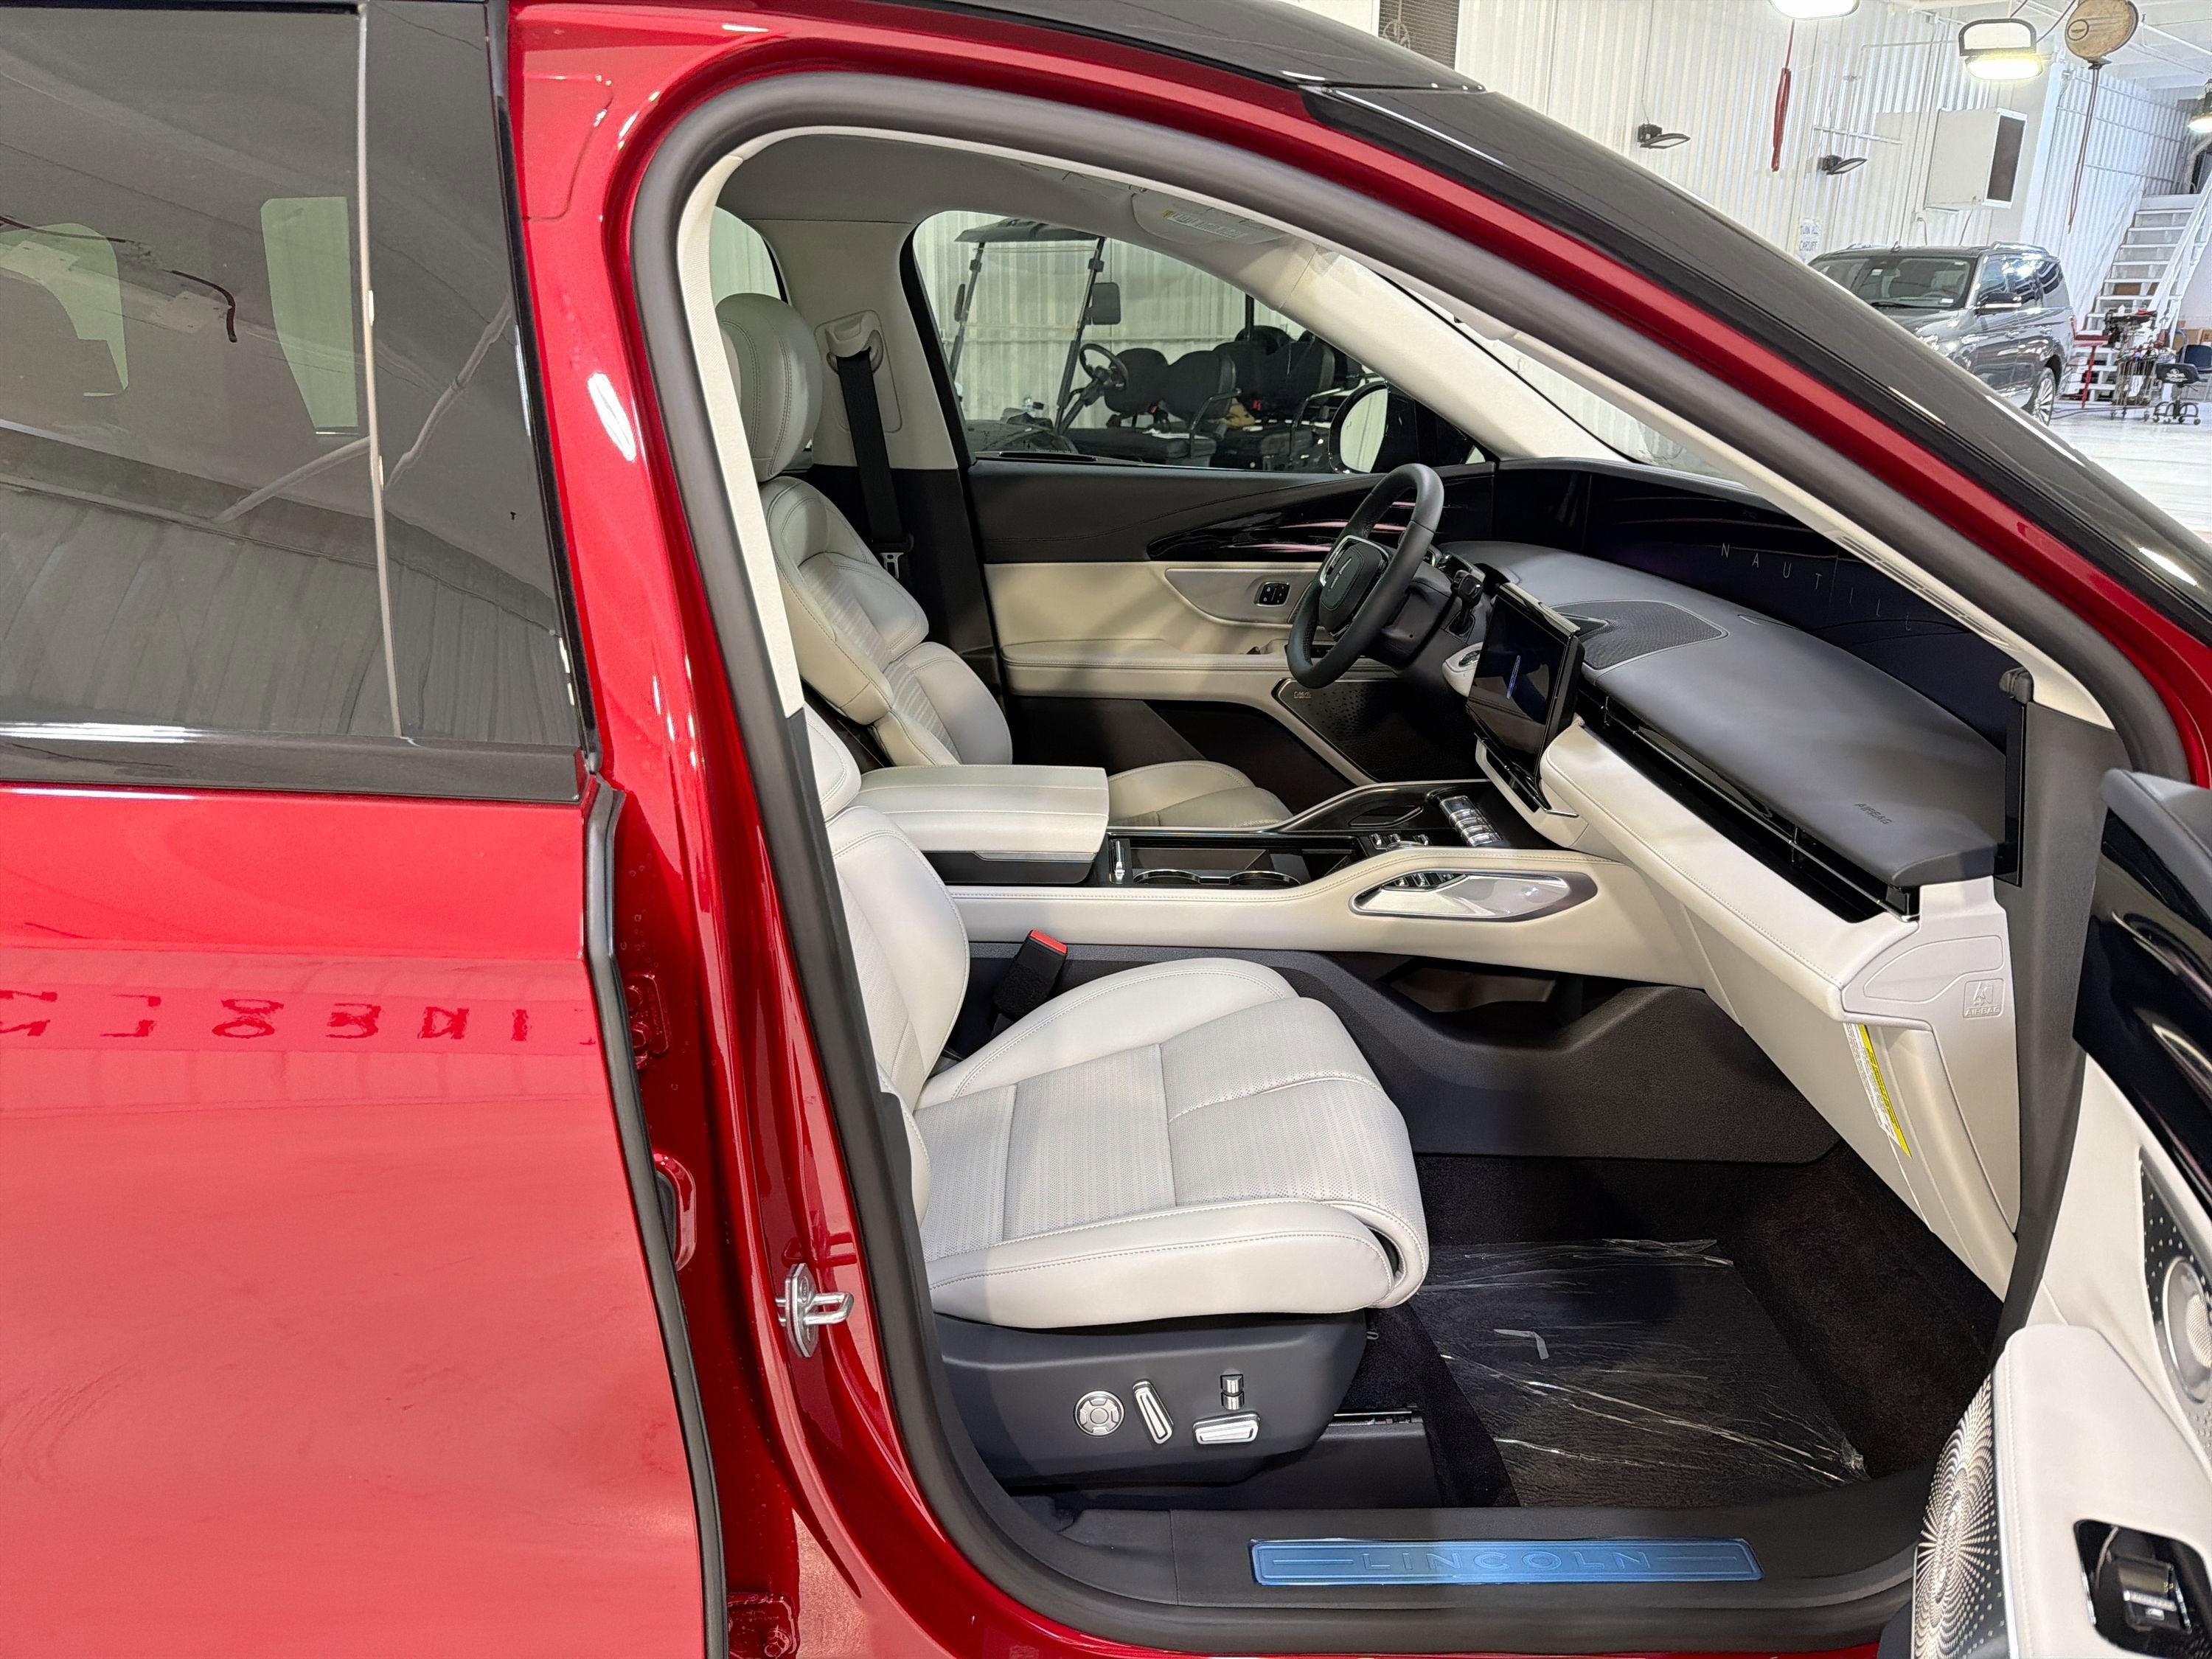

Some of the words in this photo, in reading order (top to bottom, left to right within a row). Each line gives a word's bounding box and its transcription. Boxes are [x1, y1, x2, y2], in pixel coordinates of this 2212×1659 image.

[1854, 803, 1893, 825] AIRBAG
[1964, 1006, 2000, 1017] AIRBAG
[1362, 1550, 1650, 1571] LINCOLN
